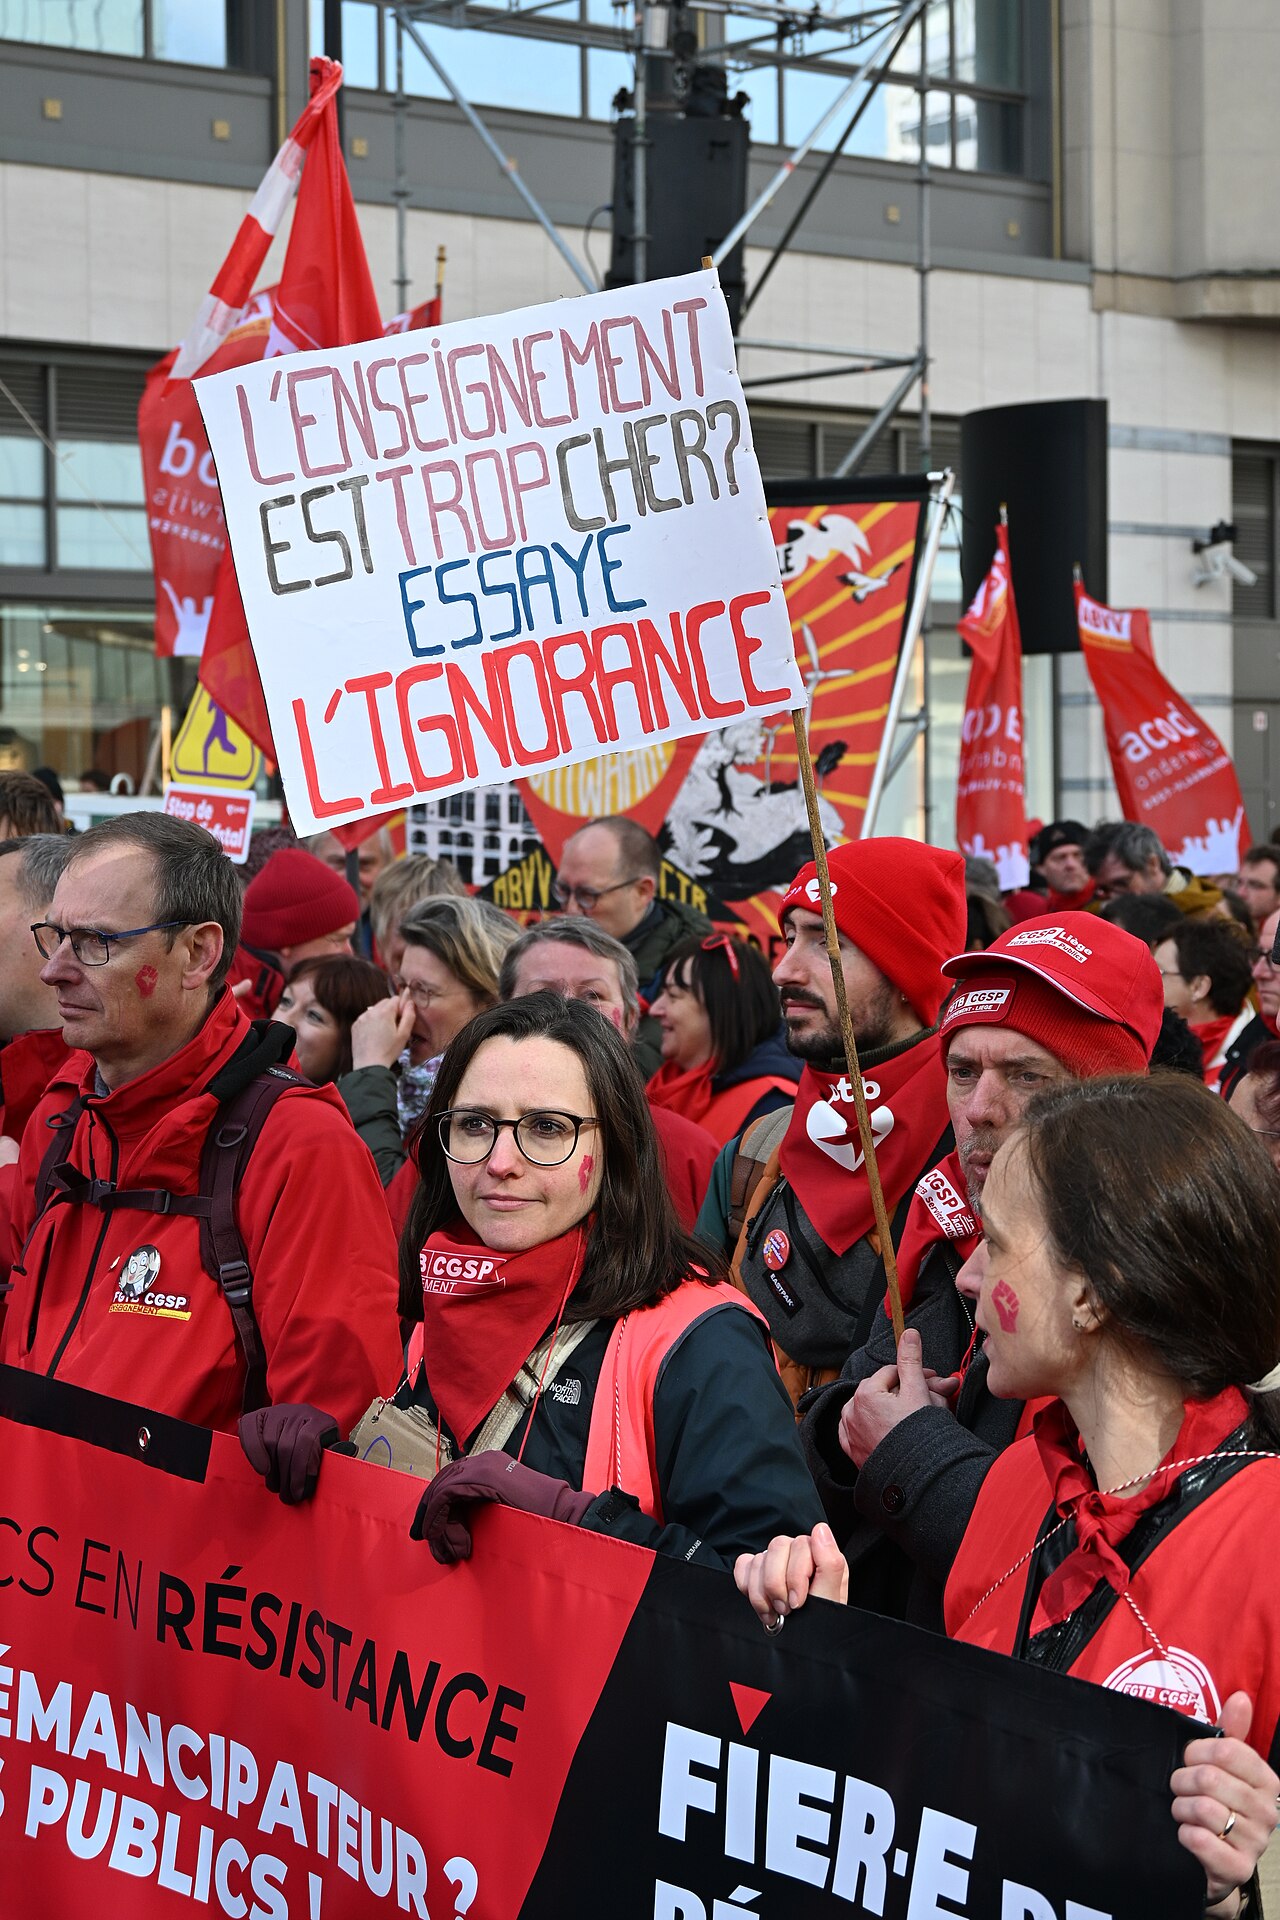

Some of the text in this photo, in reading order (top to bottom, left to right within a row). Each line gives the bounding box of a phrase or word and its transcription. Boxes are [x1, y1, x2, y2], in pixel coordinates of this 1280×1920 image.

[236, 298, 708, 485] L'ENSEIGNEMENT
[260, 400, 741, 595] EST TROP CHER?
[399, 524, 647, 658] ESSAYE
[292, 591, 792, 819] L'IGNORANCE
[1120, 700, 1199, 763] acod
[196, 799, 214, 821] de
[493, 849, 551, 909] ABVV
[1017, 928, 1094, 957] CGSP Liège
[970, 992, 1004, 1003] CGSP
[924, 1172, 959, 1208] CGSP
[925, 1196, 946, 1224] Services
[432, 1256, 494, 1281] CGSP
[144, 1292, 187, 1309] CGSP
[769, 1273, 794, 1307] EASTPAK
[552, 1393, 574, 1405] FACE
[565, 1378, 578, 1388] THE
[75, 1538, 143, 1631] EN
[156, 1565, 527, 1779] RÉSISTANCE
[1122, 1684, 1156, 1699] FGTB
[1158, 1689, 1197, 1707] CGSP
[25, 1764, 290, 1920] PUBLICS
